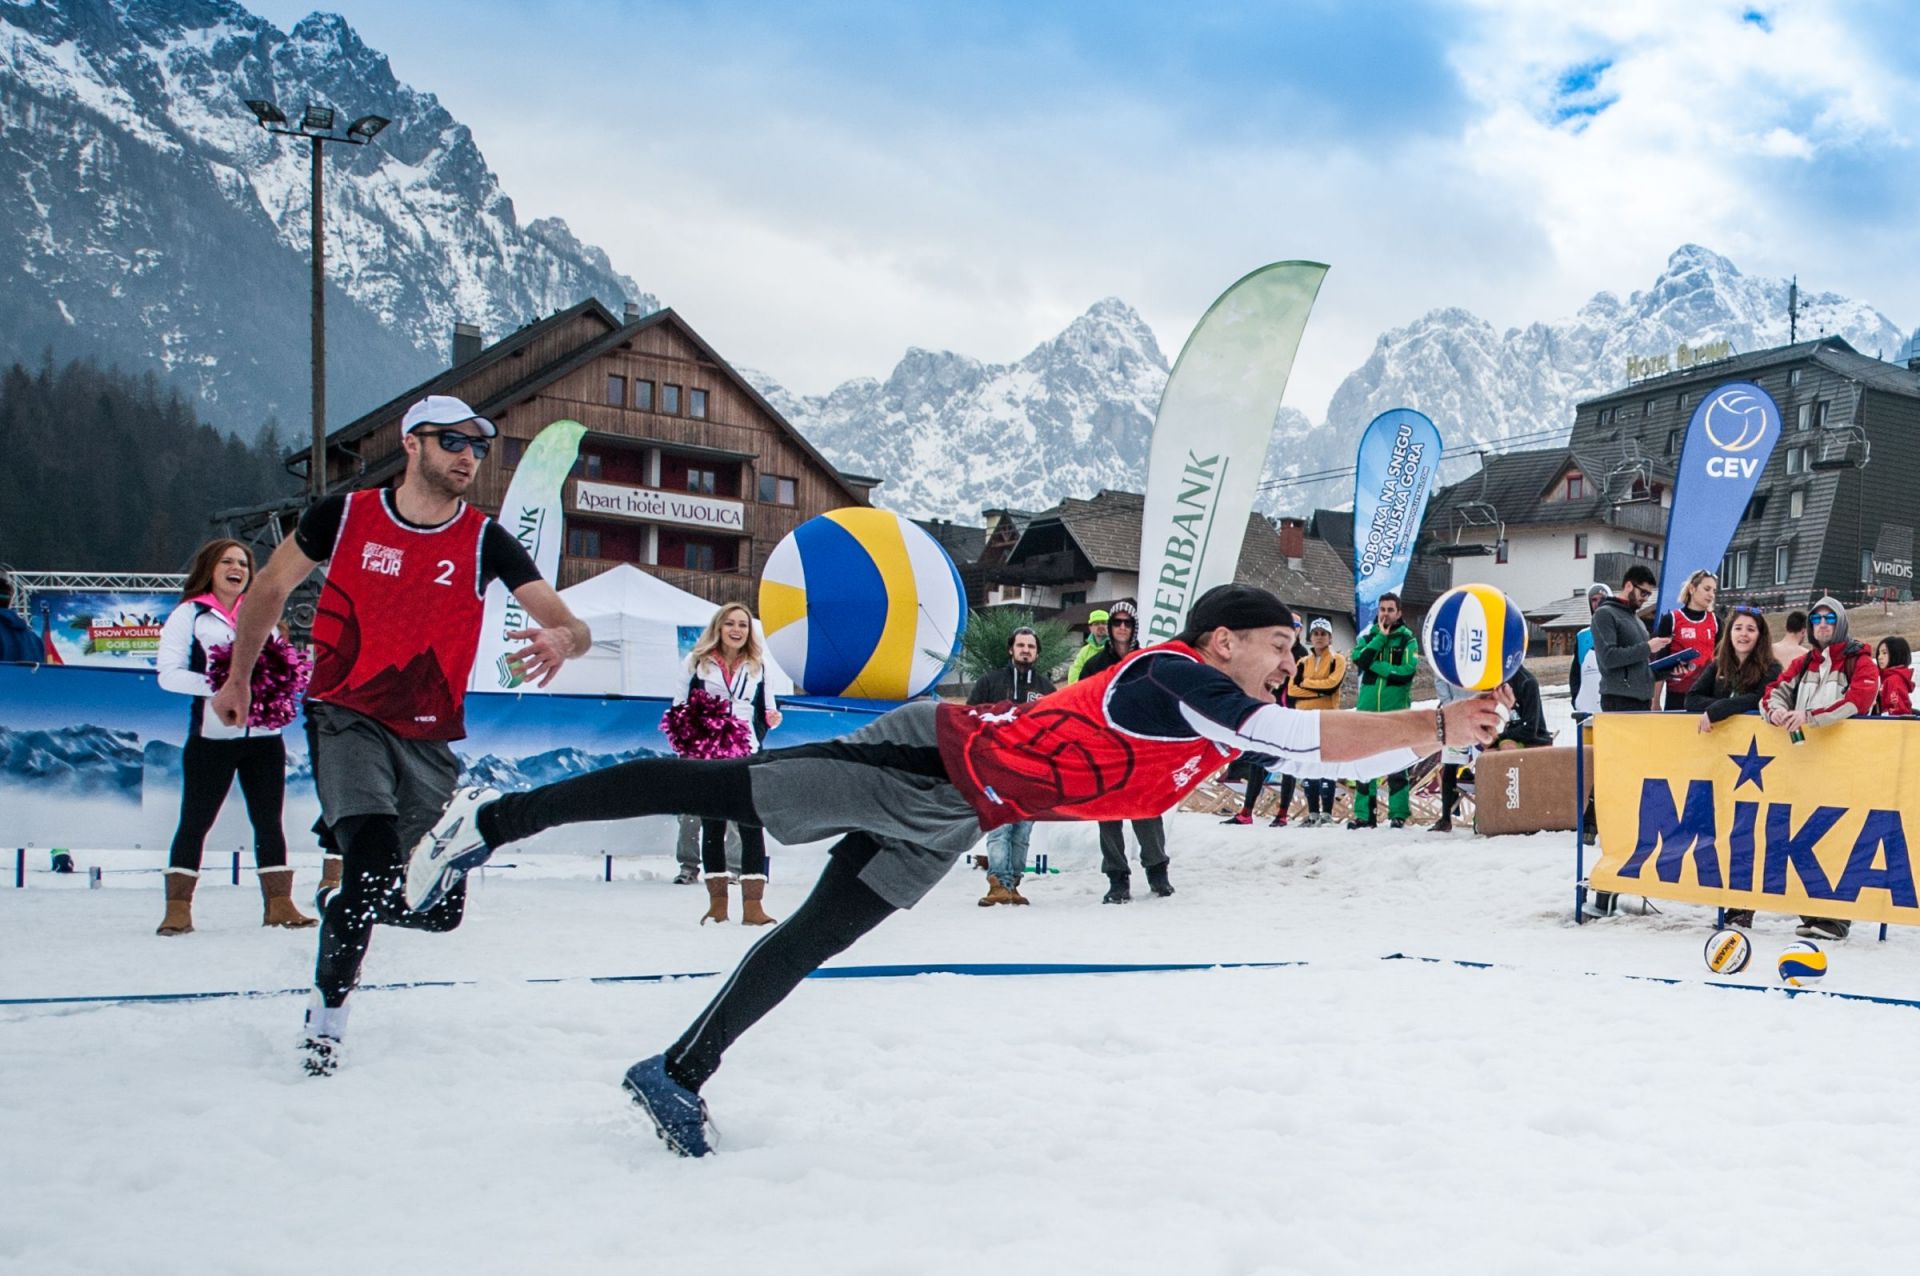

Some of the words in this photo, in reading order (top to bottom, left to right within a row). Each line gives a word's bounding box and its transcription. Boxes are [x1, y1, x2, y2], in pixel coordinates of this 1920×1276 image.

[1387, 424, 1412, 477] SNEGU
[1706, 456, 1759, 478] CEV
[1377, 490, 1409, 568] KRANJSKA
[1400, 442, 1424, 488] GORA
[1380, 479, 1397, 502] NA
[579, 490, 621, 510] Apart
[627, 495, 666, 516] hotel
[671, 502, 741, 525] VIJOLICA
[1361, 505, 1389, 576] ODBOJKA
[433, 559, 455, 586] 2
[1873, 560, 1914, 579] VIRIDIS
[1470, 629, 1483, 662] FIVB
[1706, 628, 1712, 640] 1
